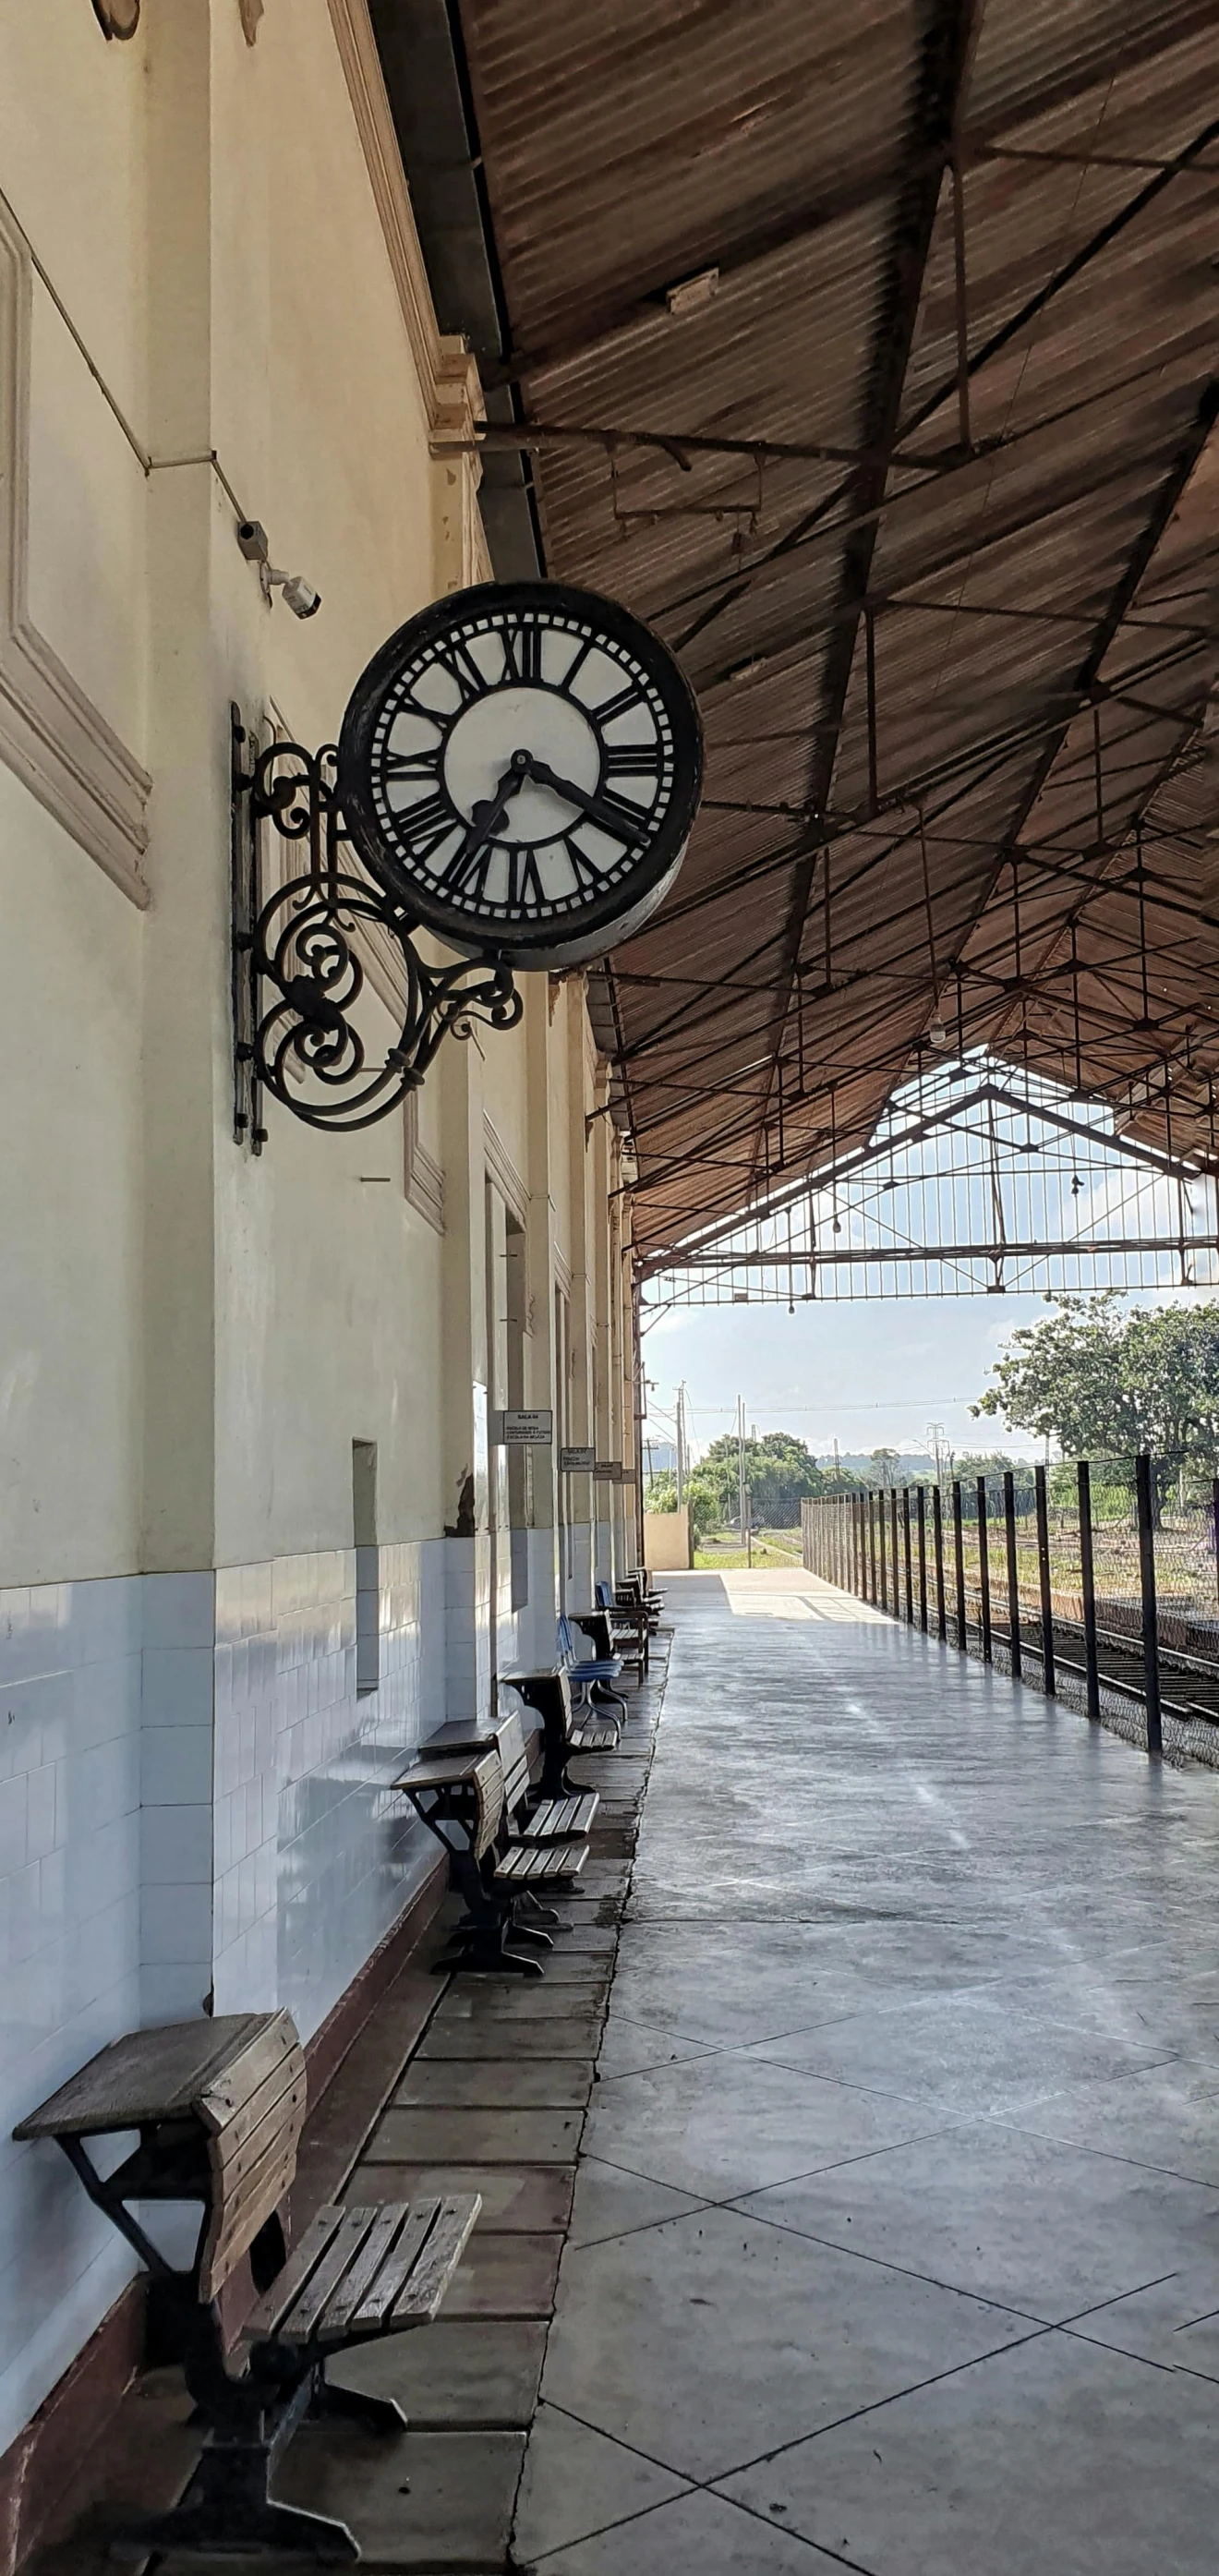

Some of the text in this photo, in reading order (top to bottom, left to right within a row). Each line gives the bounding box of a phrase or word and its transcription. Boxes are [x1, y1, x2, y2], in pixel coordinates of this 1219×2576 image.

[497, 628, 543, 683] XII
[557, 637, 594, 689] I
[395, 689, 454, 733] X
[588, 680, 648, 727] II
[383, 744, 441, 783] IX
[602, 742, 658, 779] III
[391, 793, 460, 857] VIII
[505, 845, 548, 906] VI
[560, 828, 607, 892] V
